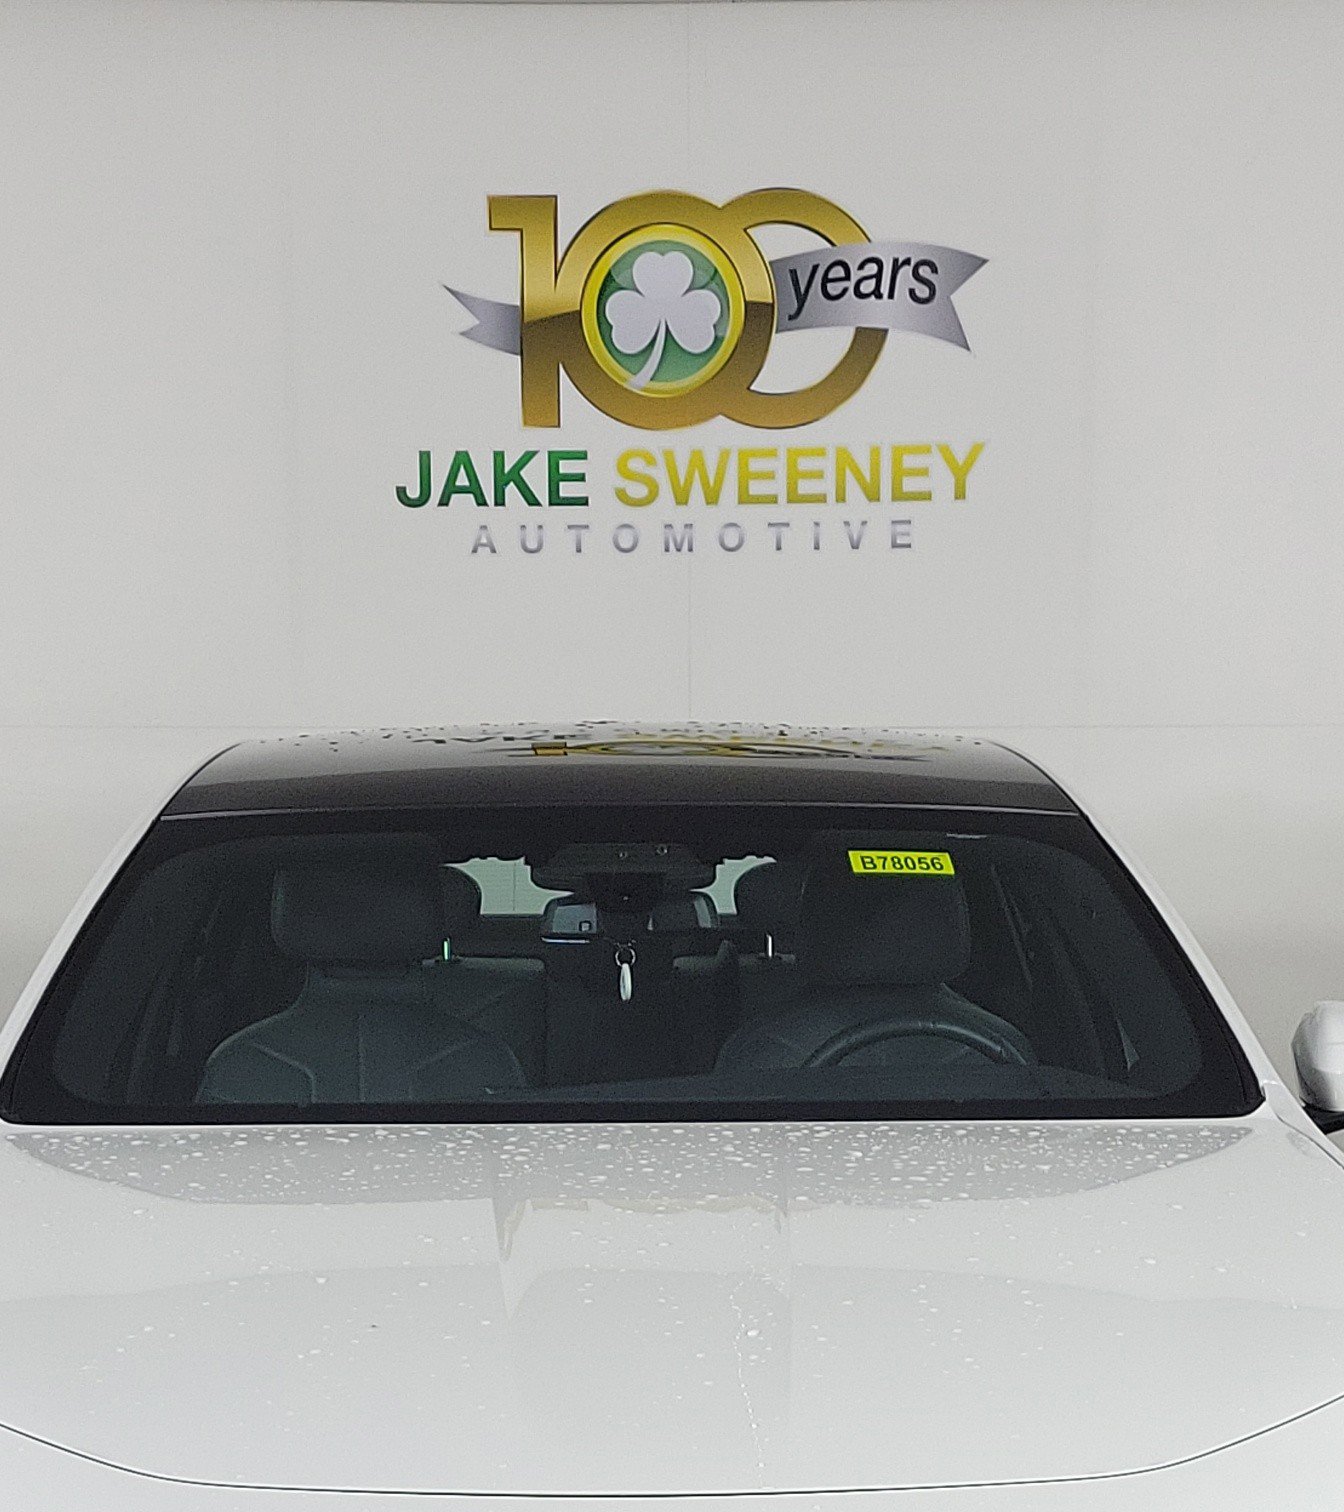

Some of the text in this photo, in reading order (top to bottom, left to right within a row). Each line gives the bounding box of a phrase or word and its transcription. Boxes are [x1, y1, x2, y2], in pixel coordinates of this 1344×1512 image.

[487, 187, 889, 431] 100
[787, 254, 938, 321] years
[395, 442, 985, 508] JAKE SWEENEY
[471, 519, 913, 555] AUTOMOTIVE
[859, 855, 944, 871] B78056
